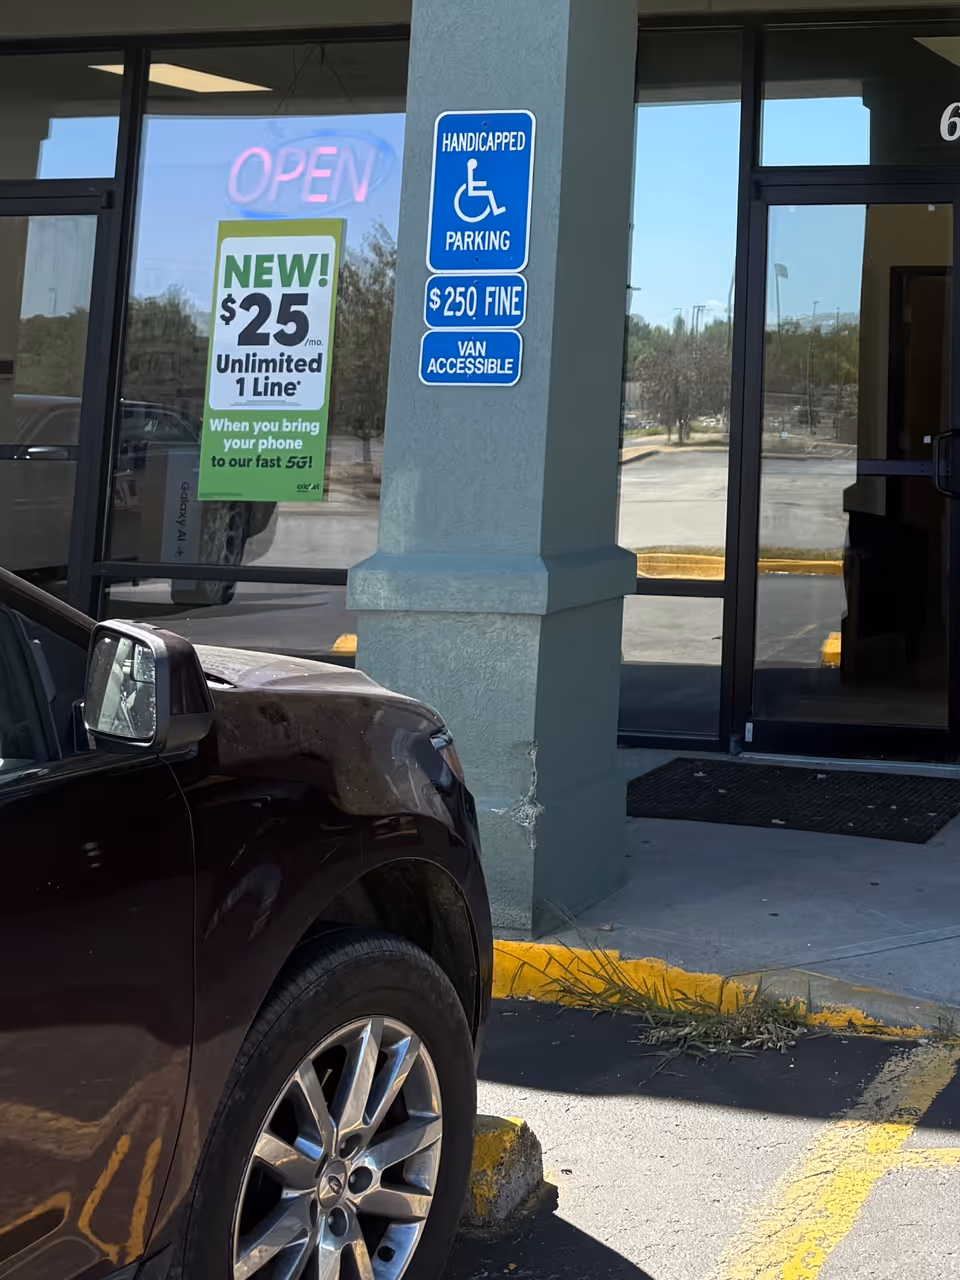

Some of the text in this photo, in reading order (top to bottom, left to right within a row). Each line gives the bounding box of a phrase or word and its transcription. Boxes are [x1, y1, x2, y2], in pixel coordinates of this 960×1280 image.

[442, 131, 526, 152] HANDICAPPED
[227, 146, 377, 203] OPEN
[445, 230, 511, 251] PARKING
[224, 253, 330, 289] NEW!
[429, 286, 522, 317] $250 FINE
[458, 341, 487, 357] VAN
[216, 352, 324, 374] Unlimited
[427, 358, 514, 375] ACCESSIBLE
[236, 377, 246, 397] 1
[209, 418, 320, 436] When you bring
[223, 436, 304, 452] your phone
[211, 455, 313, 469] to our fast 5G!
[176, 481, 191, 527] Galaxy
